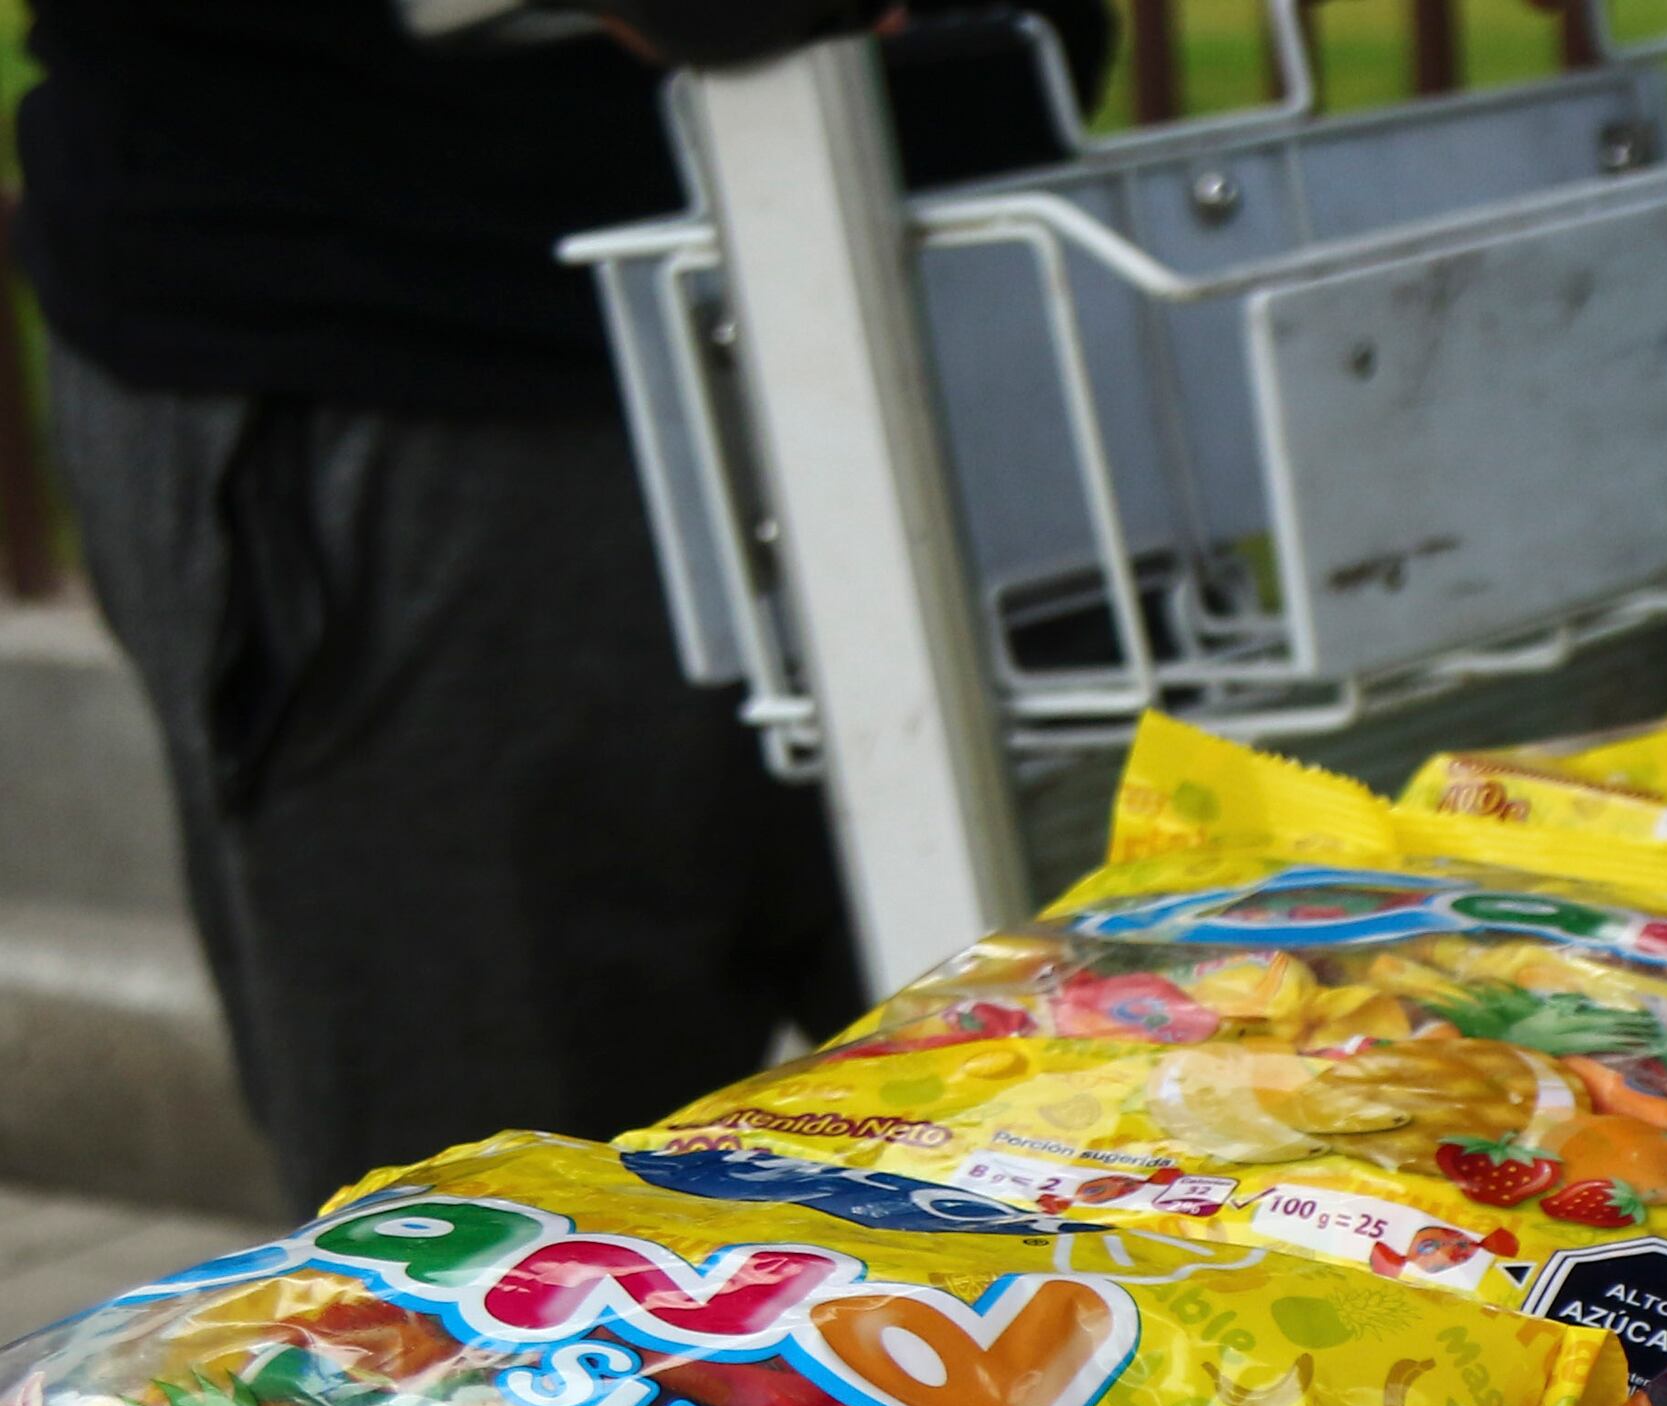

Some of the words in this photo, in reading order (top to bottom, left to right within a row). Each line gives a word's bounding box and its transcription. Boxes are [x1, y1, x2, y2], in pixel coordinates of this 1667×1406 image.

[993, 1130, 1076, 1157] Porción
[1037, 1177, 1062, 1192] 2
[1268, 1193, 1318, 1220] 100
[1317, 1210, 1331, 1230] g
[1353, 1213, 1389, 1240] 25
